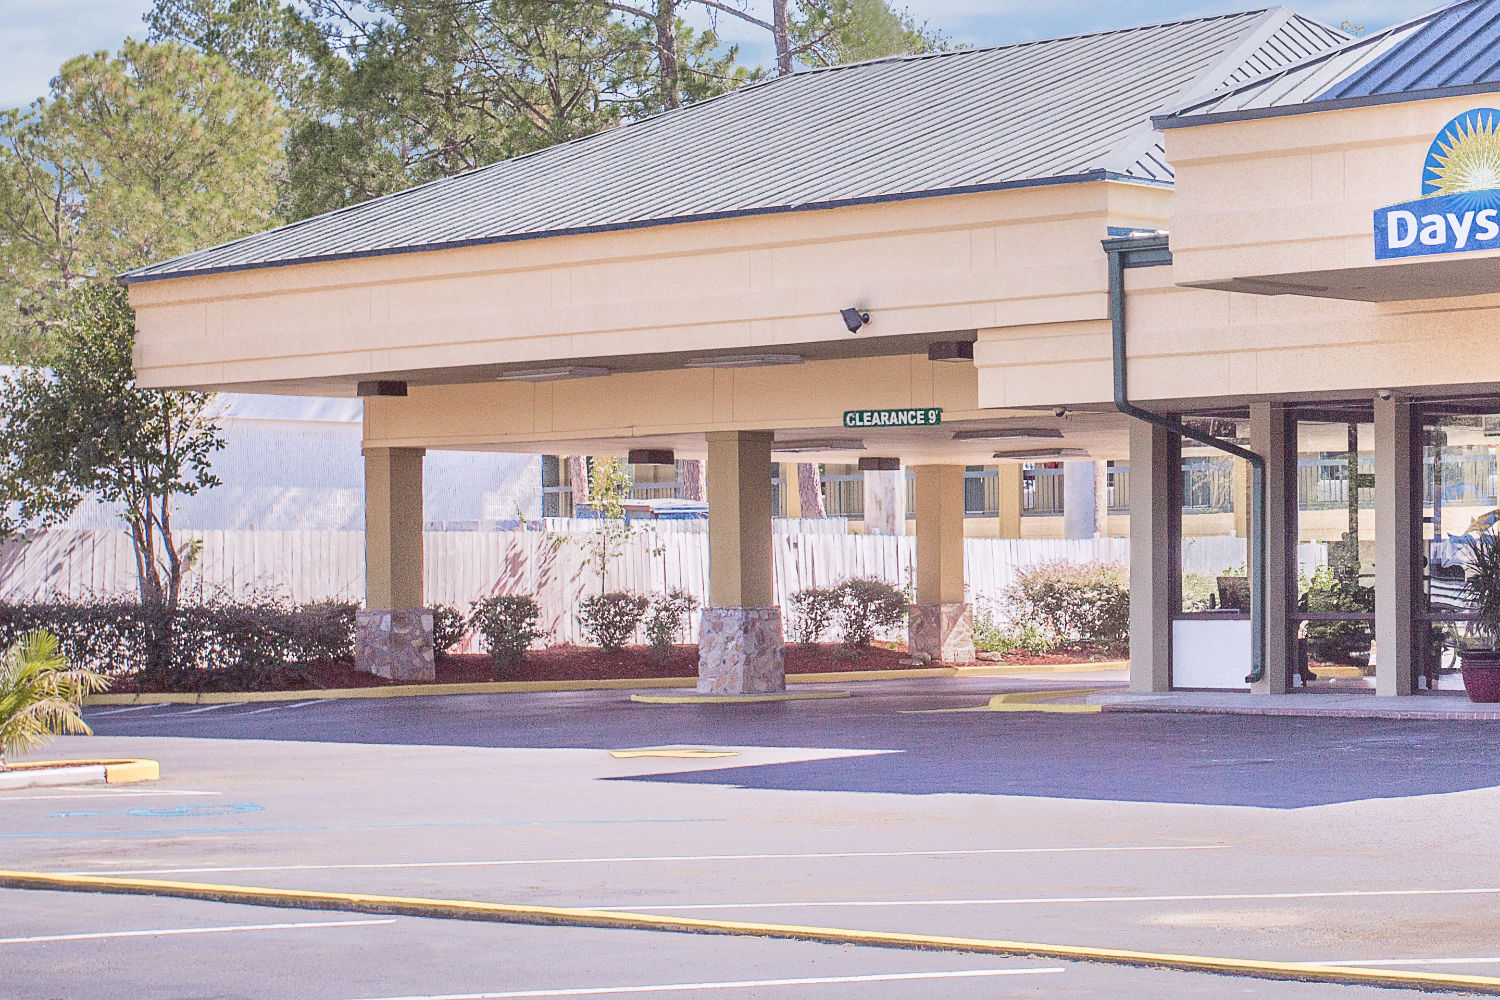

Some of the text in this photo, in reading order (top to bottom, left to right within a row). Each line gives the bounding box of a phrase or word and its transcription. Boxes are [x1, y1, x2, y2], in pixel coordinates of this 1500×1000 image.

[1387, 209, 1498, 249] Days
[846, 410, 938, 426] CLEARANCE 9'
